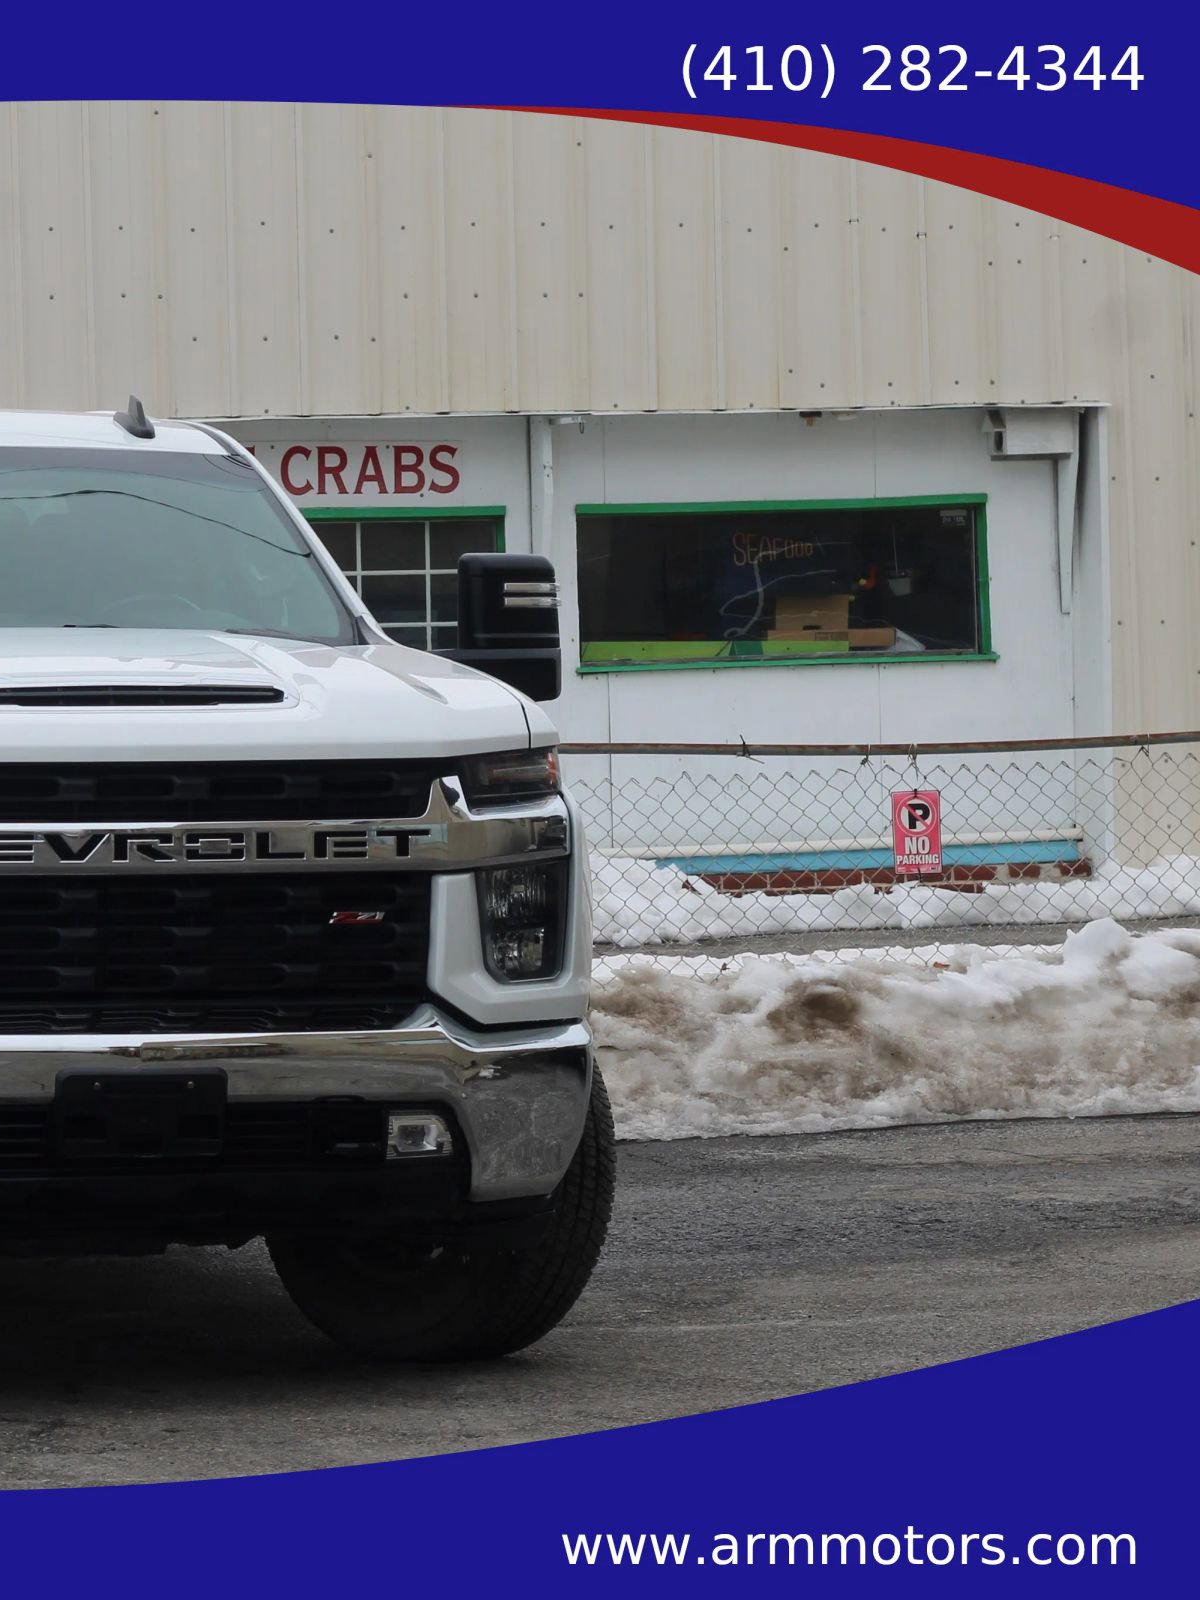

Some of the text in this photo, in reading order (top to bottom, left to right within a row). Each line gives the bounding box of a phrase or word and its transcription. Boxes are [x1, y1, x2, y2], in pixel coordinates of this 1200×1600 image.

[281, 445, 460, 496] CRABS
[904, 836, 930, 855] NO
[896, 854, 939, 865] PARKING
